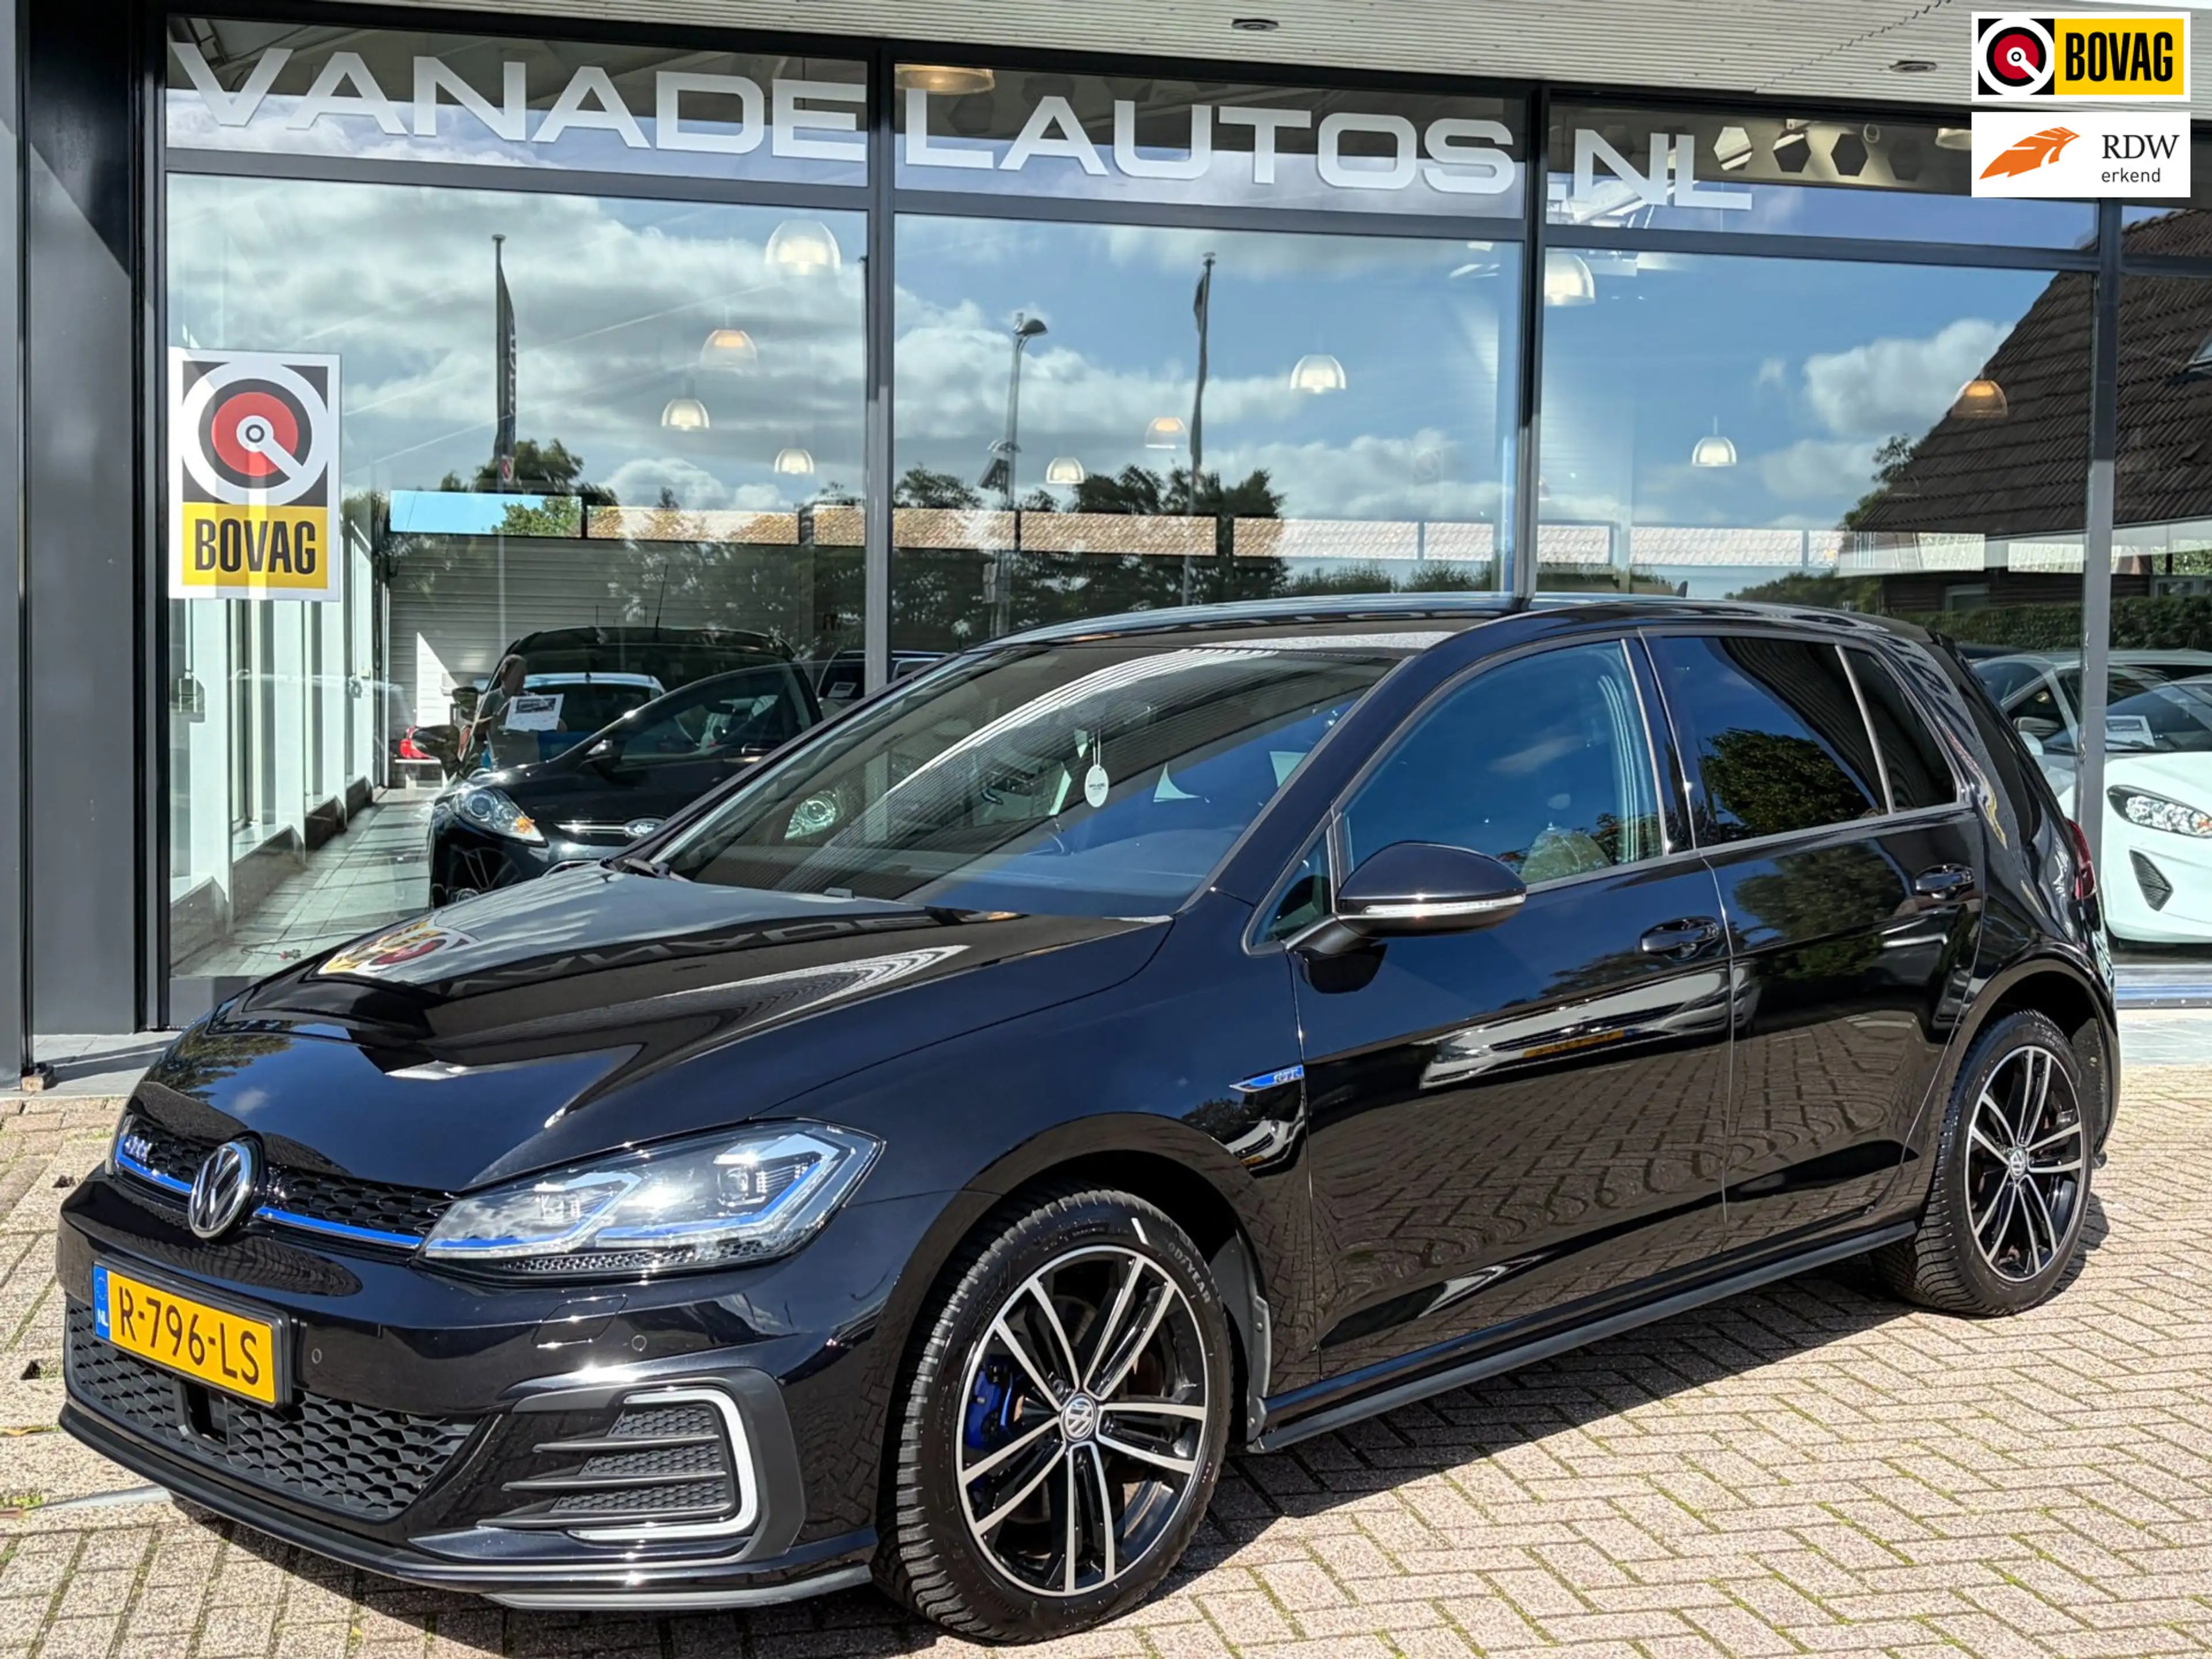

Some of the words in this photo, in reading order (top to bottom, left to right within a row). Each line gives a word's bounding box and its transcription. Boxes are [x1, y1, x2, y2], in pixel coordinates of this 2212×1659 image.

[195, 518, 316, 575] BOVAG
[97, 1308, 108, 1327] NL
[119, 1286, 259, 1385] R-796-LS
